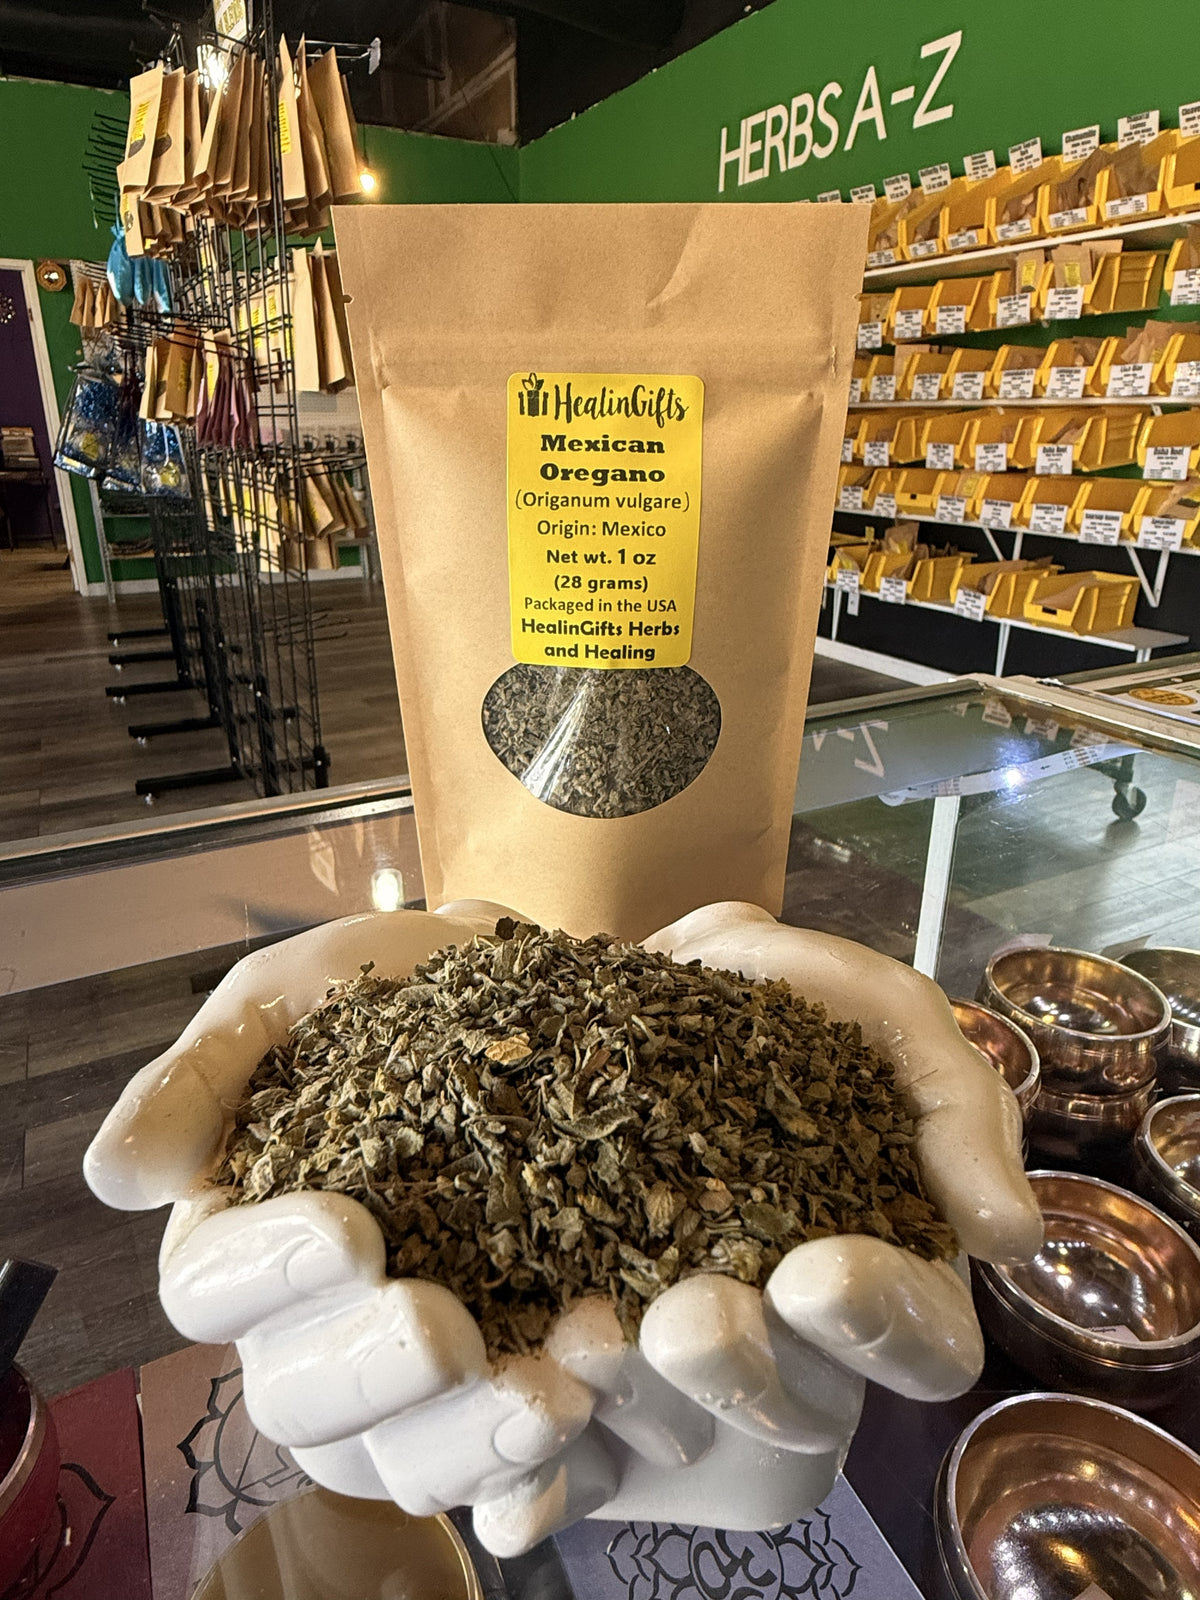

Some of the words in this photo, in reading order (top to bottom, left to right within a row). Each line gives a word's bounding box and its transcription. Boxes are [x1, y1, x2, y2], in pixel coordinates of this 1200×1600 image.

[718, 81, 843, 193] HERBS
[843, 30, 963, 152] A-Z
[554, 382, 689, 428] HealinGifts
[541, 434, 665, 454] Mexican
[540, 462, 665, 486] Oregano
[515, 490, 610, 511] (Origanum
[616, 491, 690, 513] vulgare)
[537, 520, 597, 539] Origin:
[602, 521, 666, 537] Mexico
[547, 549, 578, 564] Net
[584, 551, 612, 564] wt.
[618, 549, 626, 565] 1
[633, 553, 656, 565] oz
[554, 575, 582, 592] (28
[588, 575, 649, 593] grams)
[524, 597, 594, 614] Packaged
[598, 599, 612, 612] in
[616, 598, 642, 612] the
[647, 600, 677, 612] USA
[521, 618, 623, 636] HealinGifts
[628, 620, 680, 637] Herbs
[544, 644, 579, 658] and
[585, 645, 656, 661] Healing
